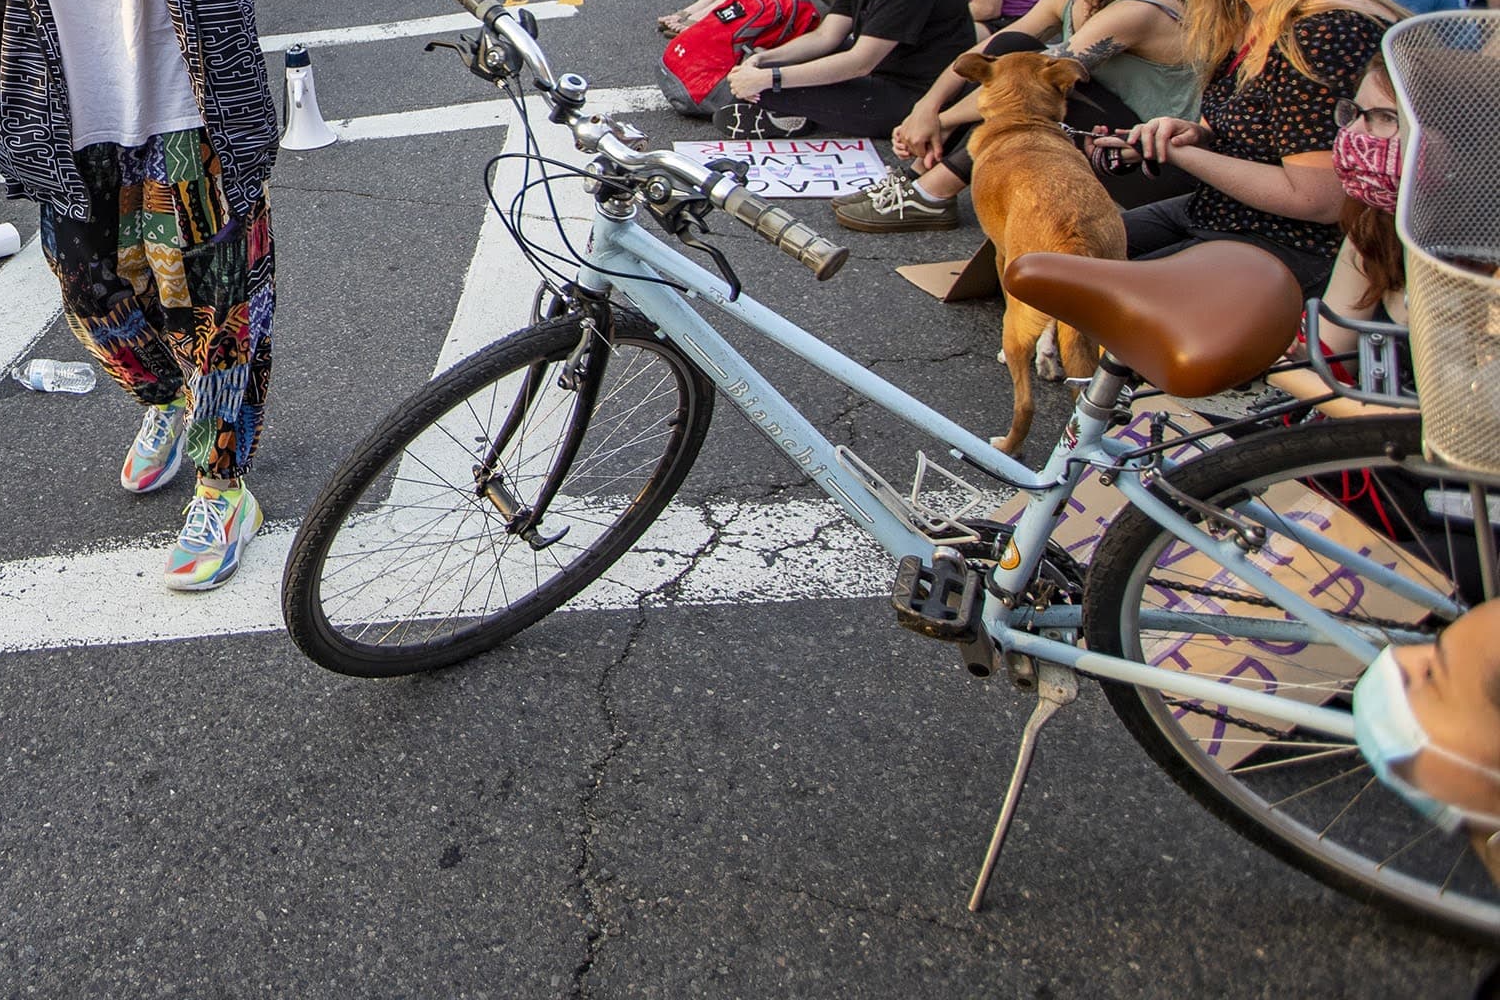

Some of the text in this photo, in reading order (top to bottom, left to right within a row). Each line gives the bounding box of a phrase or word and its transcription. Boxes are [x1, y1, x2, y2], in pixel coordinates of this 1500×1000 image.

[692, 139, 865, 153] MATTER
[750, 178, 875, 192] BLAC
[728, 377, 828, 475] Bianchi
